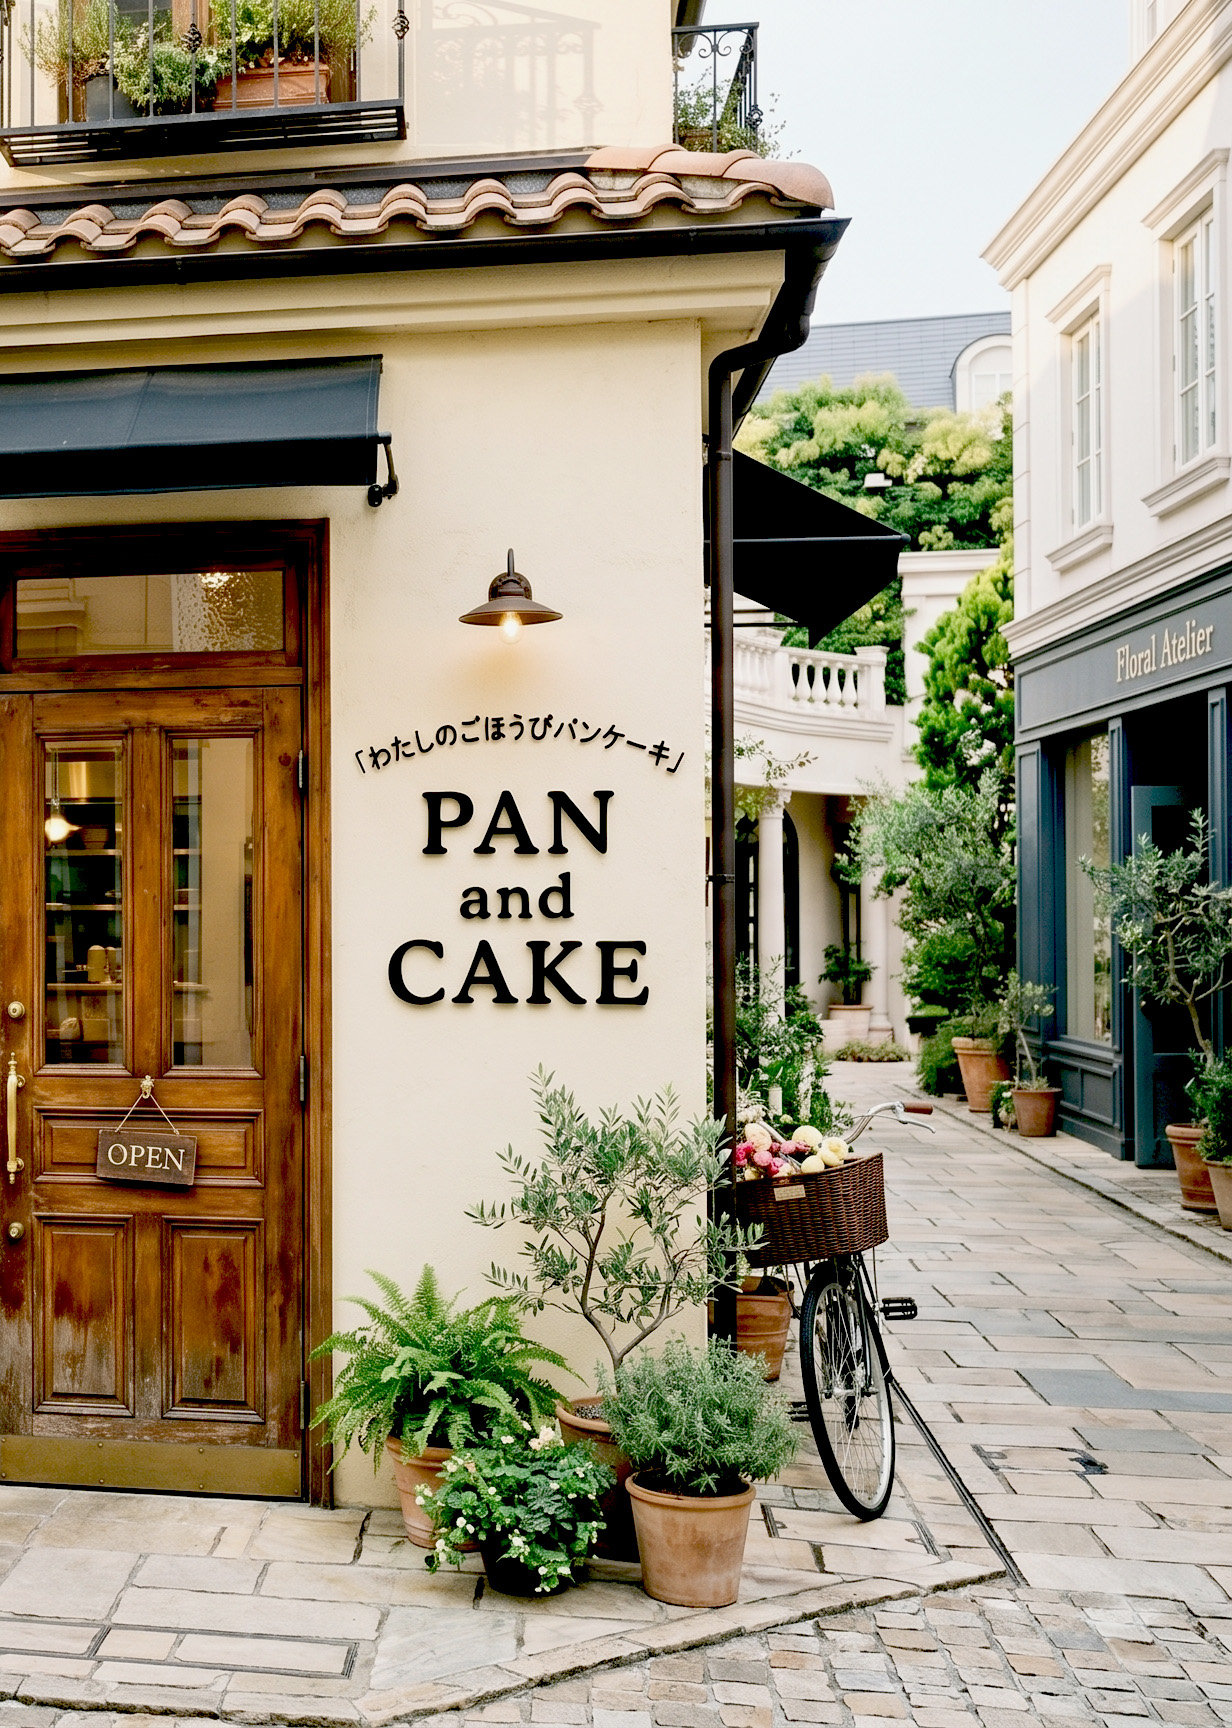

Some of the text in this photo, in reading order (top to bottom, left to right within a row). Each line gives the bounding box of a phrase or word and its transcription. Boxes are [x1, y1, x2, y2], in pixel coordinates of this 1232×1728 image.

[1116, 619, 1214, 683] Floral Atelier
[354, 713, 685, 774] 「わたしのごほうびパンケーキ」
[421, 790, 615, 855] PAN
[459, 871, 575, 920] and
[388, 939, 650, 1006] CAKE
[107, 1143, 186, 1172] OPEN
